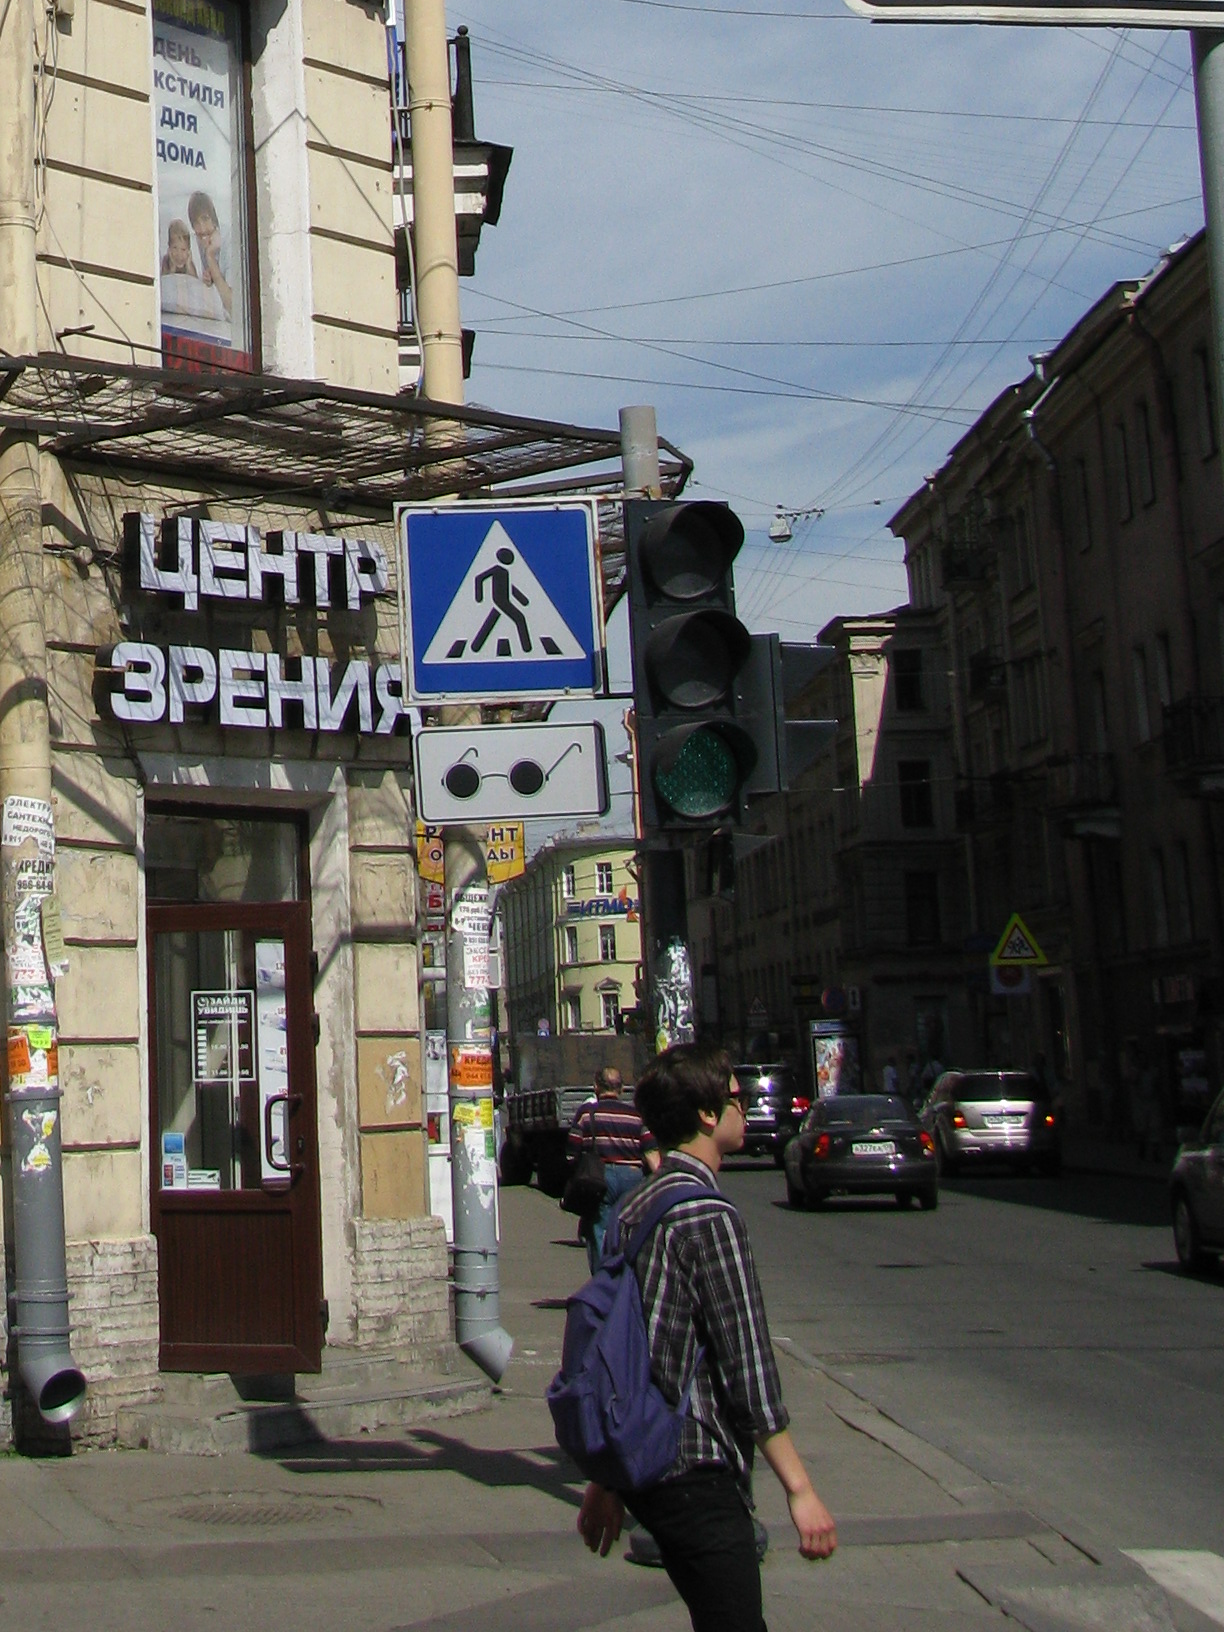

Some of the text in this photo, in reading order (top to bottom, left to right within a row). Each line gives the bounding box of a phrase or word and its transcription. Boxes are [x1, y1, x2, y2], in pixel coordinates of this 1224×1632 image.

[152, 34, 202, 67] ДЕНЬ
[160, 106, 198, 134] ДЛЯ
[155, 137, 207, 170] ДОМА
[139, 512, 389, 611] ЦЕНТР
[108, 642, 422, 736] ЗРЕНИЯ
